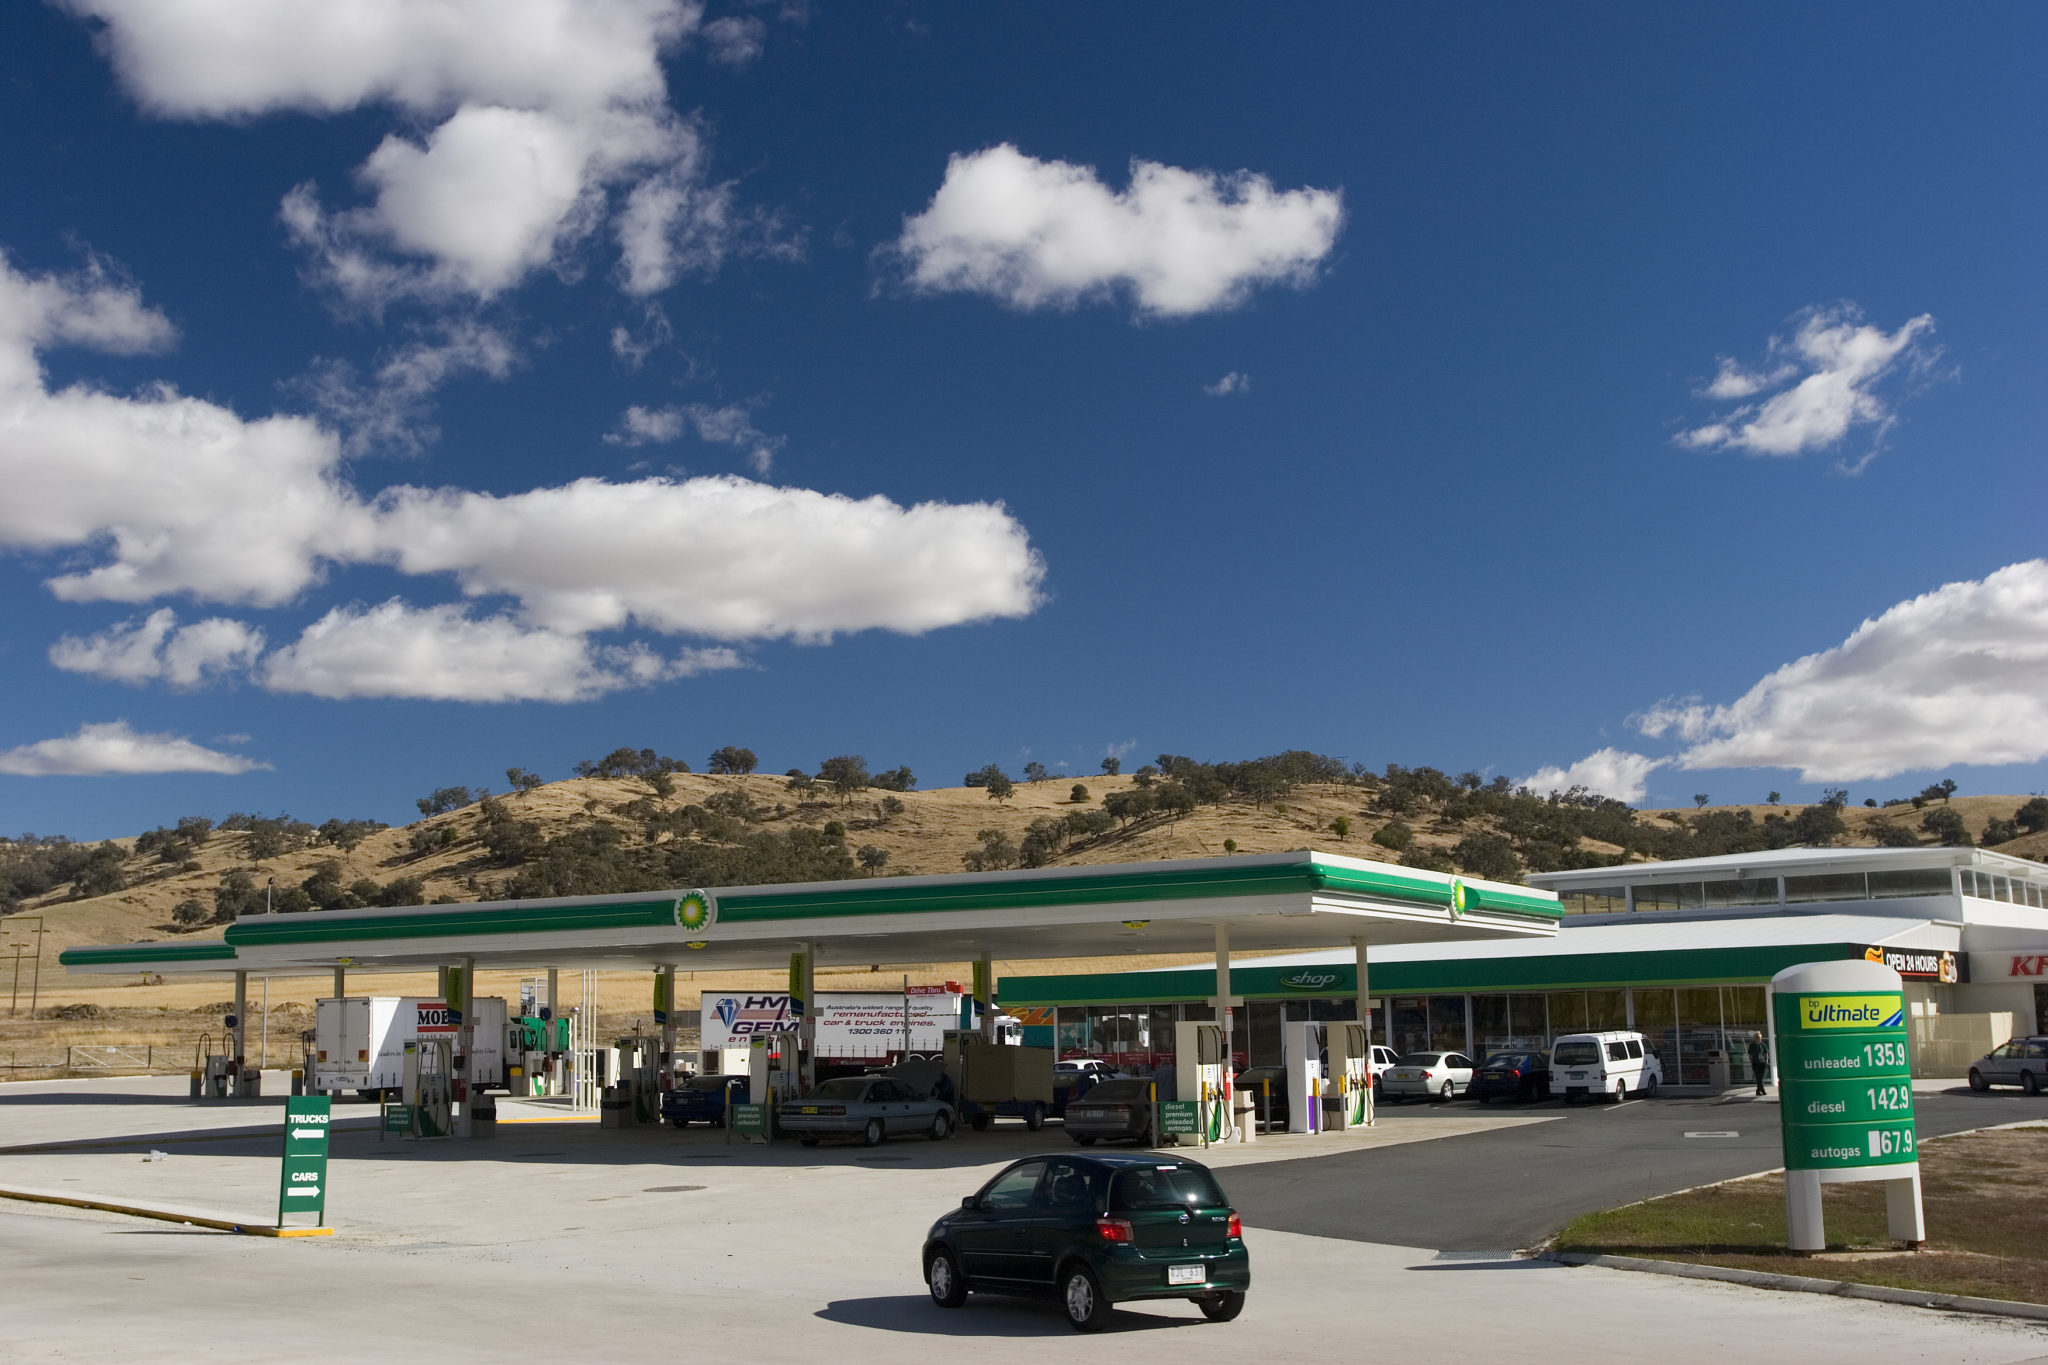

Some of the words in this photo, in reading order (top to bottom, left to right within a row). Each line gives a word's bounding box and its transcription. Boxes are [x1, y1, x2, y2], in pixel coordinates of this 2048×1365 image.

[1886, 953, 1905, 971] OPEN
[1906, 955, 1915, 972] 24
[1915, 955, 1938, 972] HOURS
[1291, 971, 1336, 987] shop
[1808, 999, 1820, 1009] bp
[417, 1010, 449, 1025] MOE
[1809, 1004, 1880, 1022] ultimate
[890, 1019, 936, 1028] enines.
[1804, 1056, 1861, 1069] unleaded
[1863, 1043, 1905, 1067] 135.9
[1807, 1100, 1846, 1113] diesel
[1867, 1086, 1909, 1110] 142.9
[289, 1114, 328, 1124] TRUCKS
[1165, 1110, 1193, 1118] premium
[1811, 1147, 1861, 1160] autogas
[1881, 1129, 1913, 1154] 67.9
[291, 1172, 318, 1182] CARS
